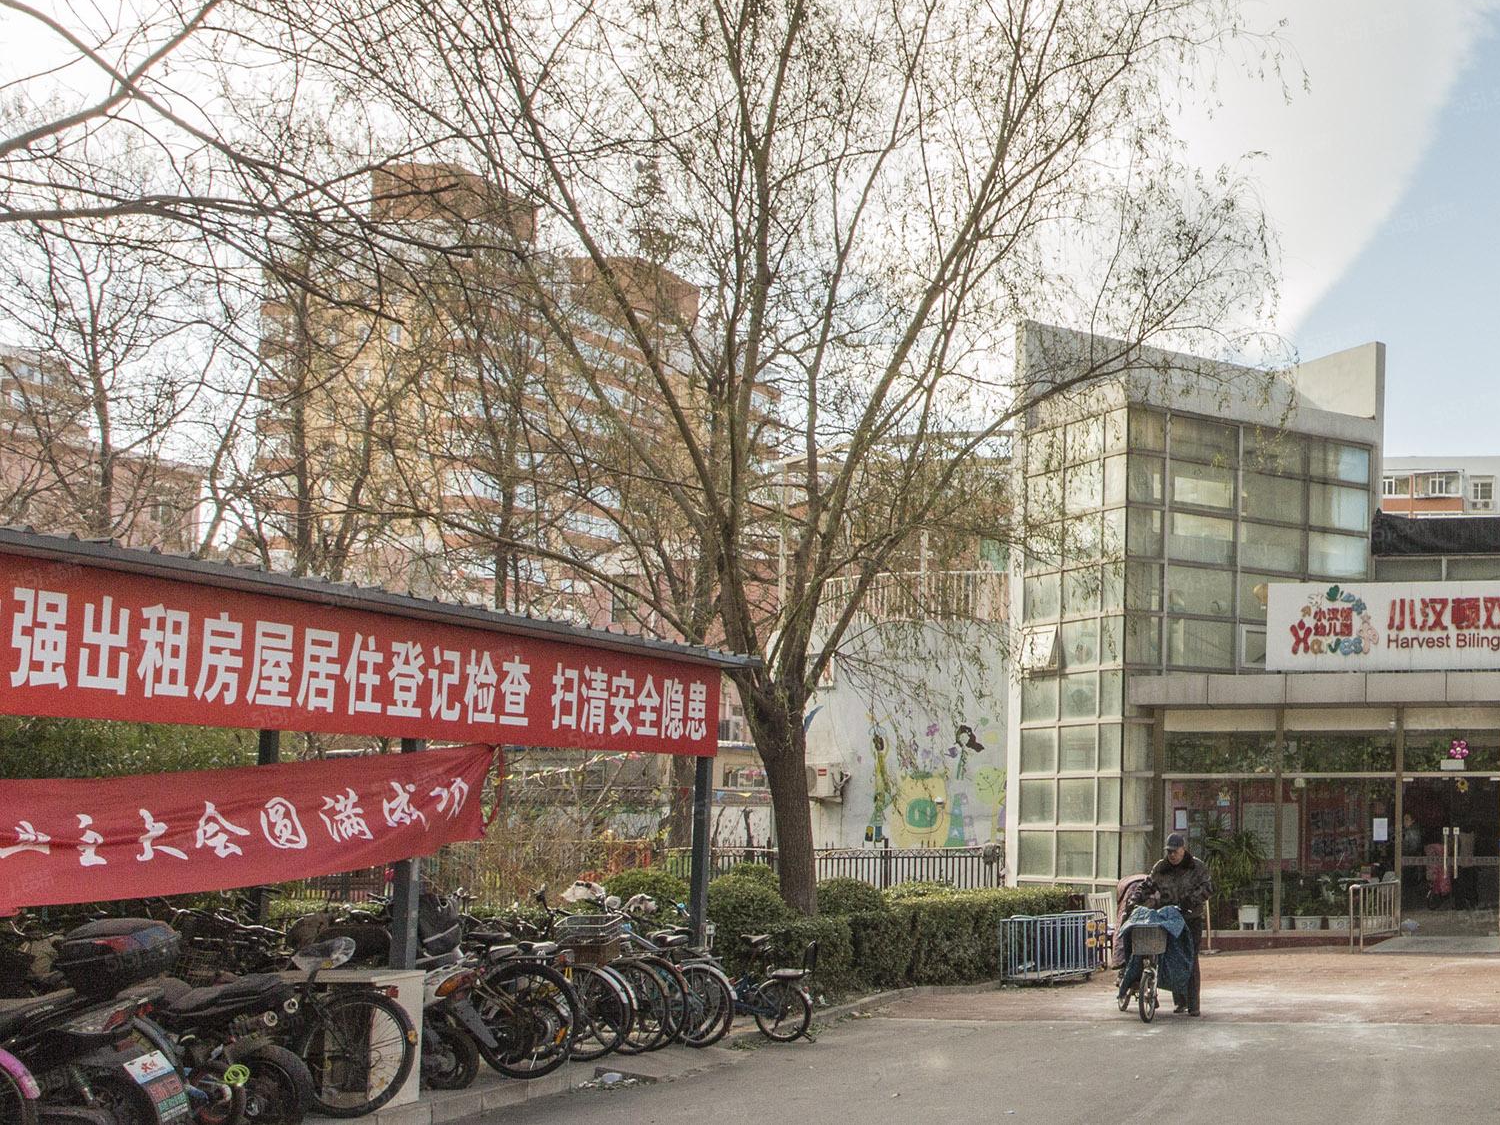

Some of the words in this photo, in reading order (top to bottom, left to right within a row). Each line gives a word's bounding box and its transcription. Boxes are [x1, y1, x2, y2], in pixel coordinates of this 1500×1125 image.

[10, 587, 531, 727] 强出租房屋居住登记检查
[551, 662, 707, 741] 扫清安全隐患
[1387, 632, 1451, 650] Harvest
